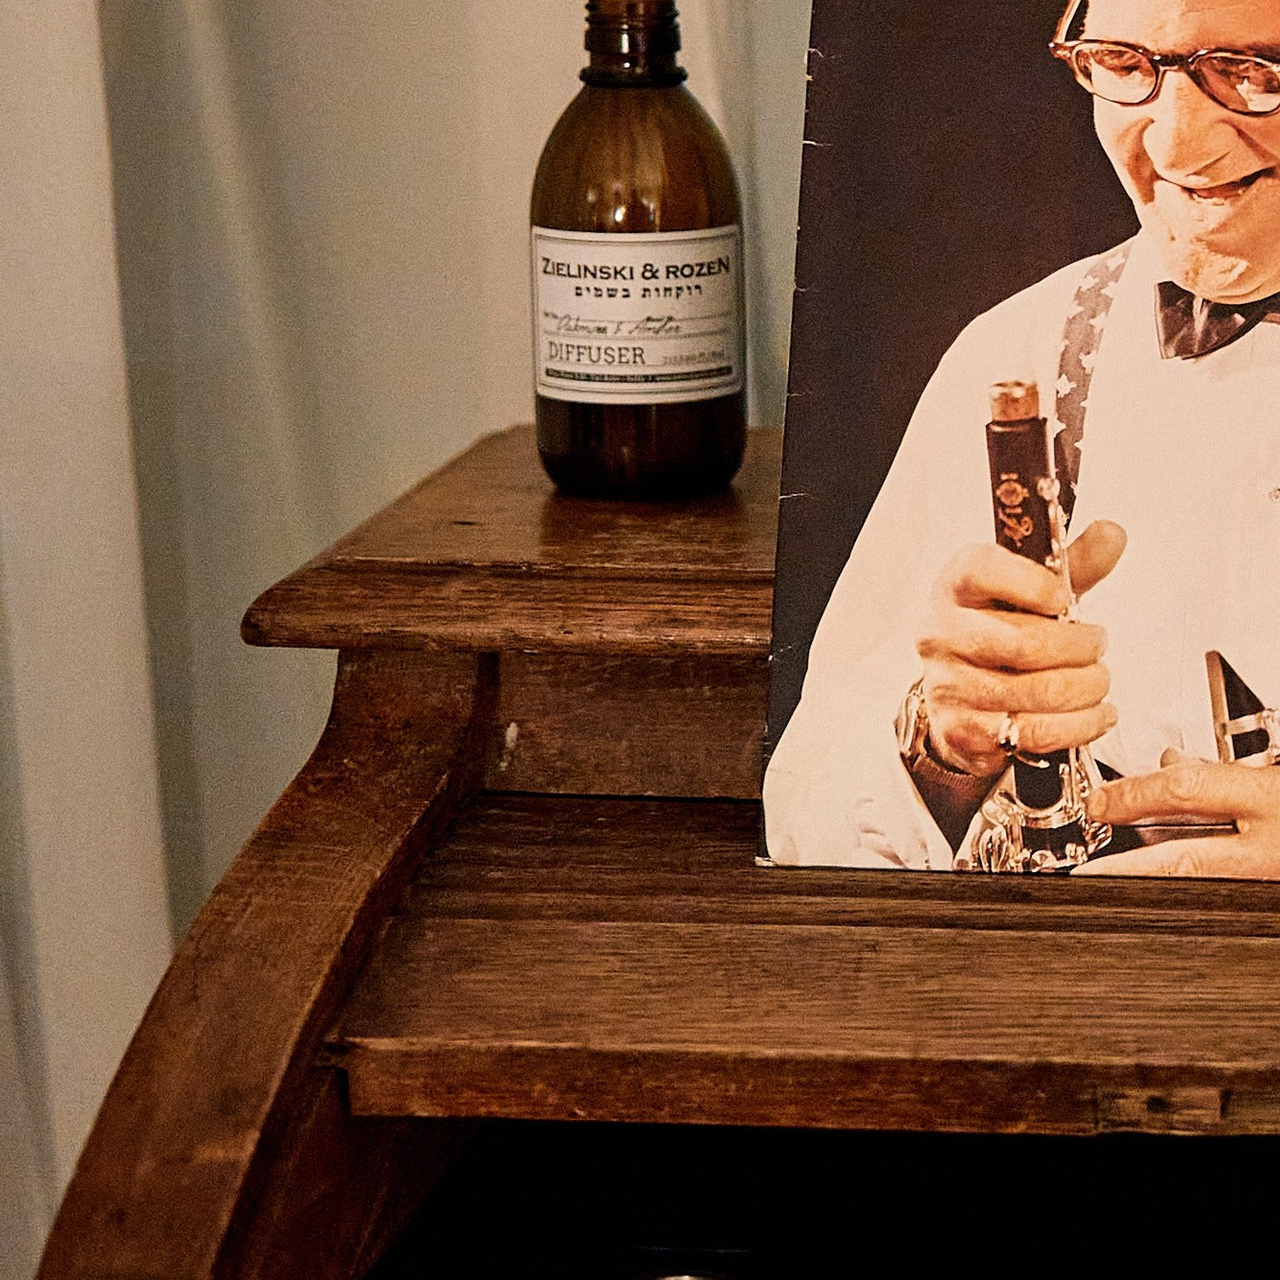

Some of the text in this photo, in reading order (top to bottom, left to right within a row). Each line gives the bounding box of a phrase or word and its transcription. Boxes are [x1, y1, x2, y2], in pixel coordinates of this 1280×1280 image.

[541, 255, 731, 281] ZIELINSKI & ROZEN
[574, 284, 703, 299] רוקחות בשמים
[547, 340, 647, 365] DIFFUSER
